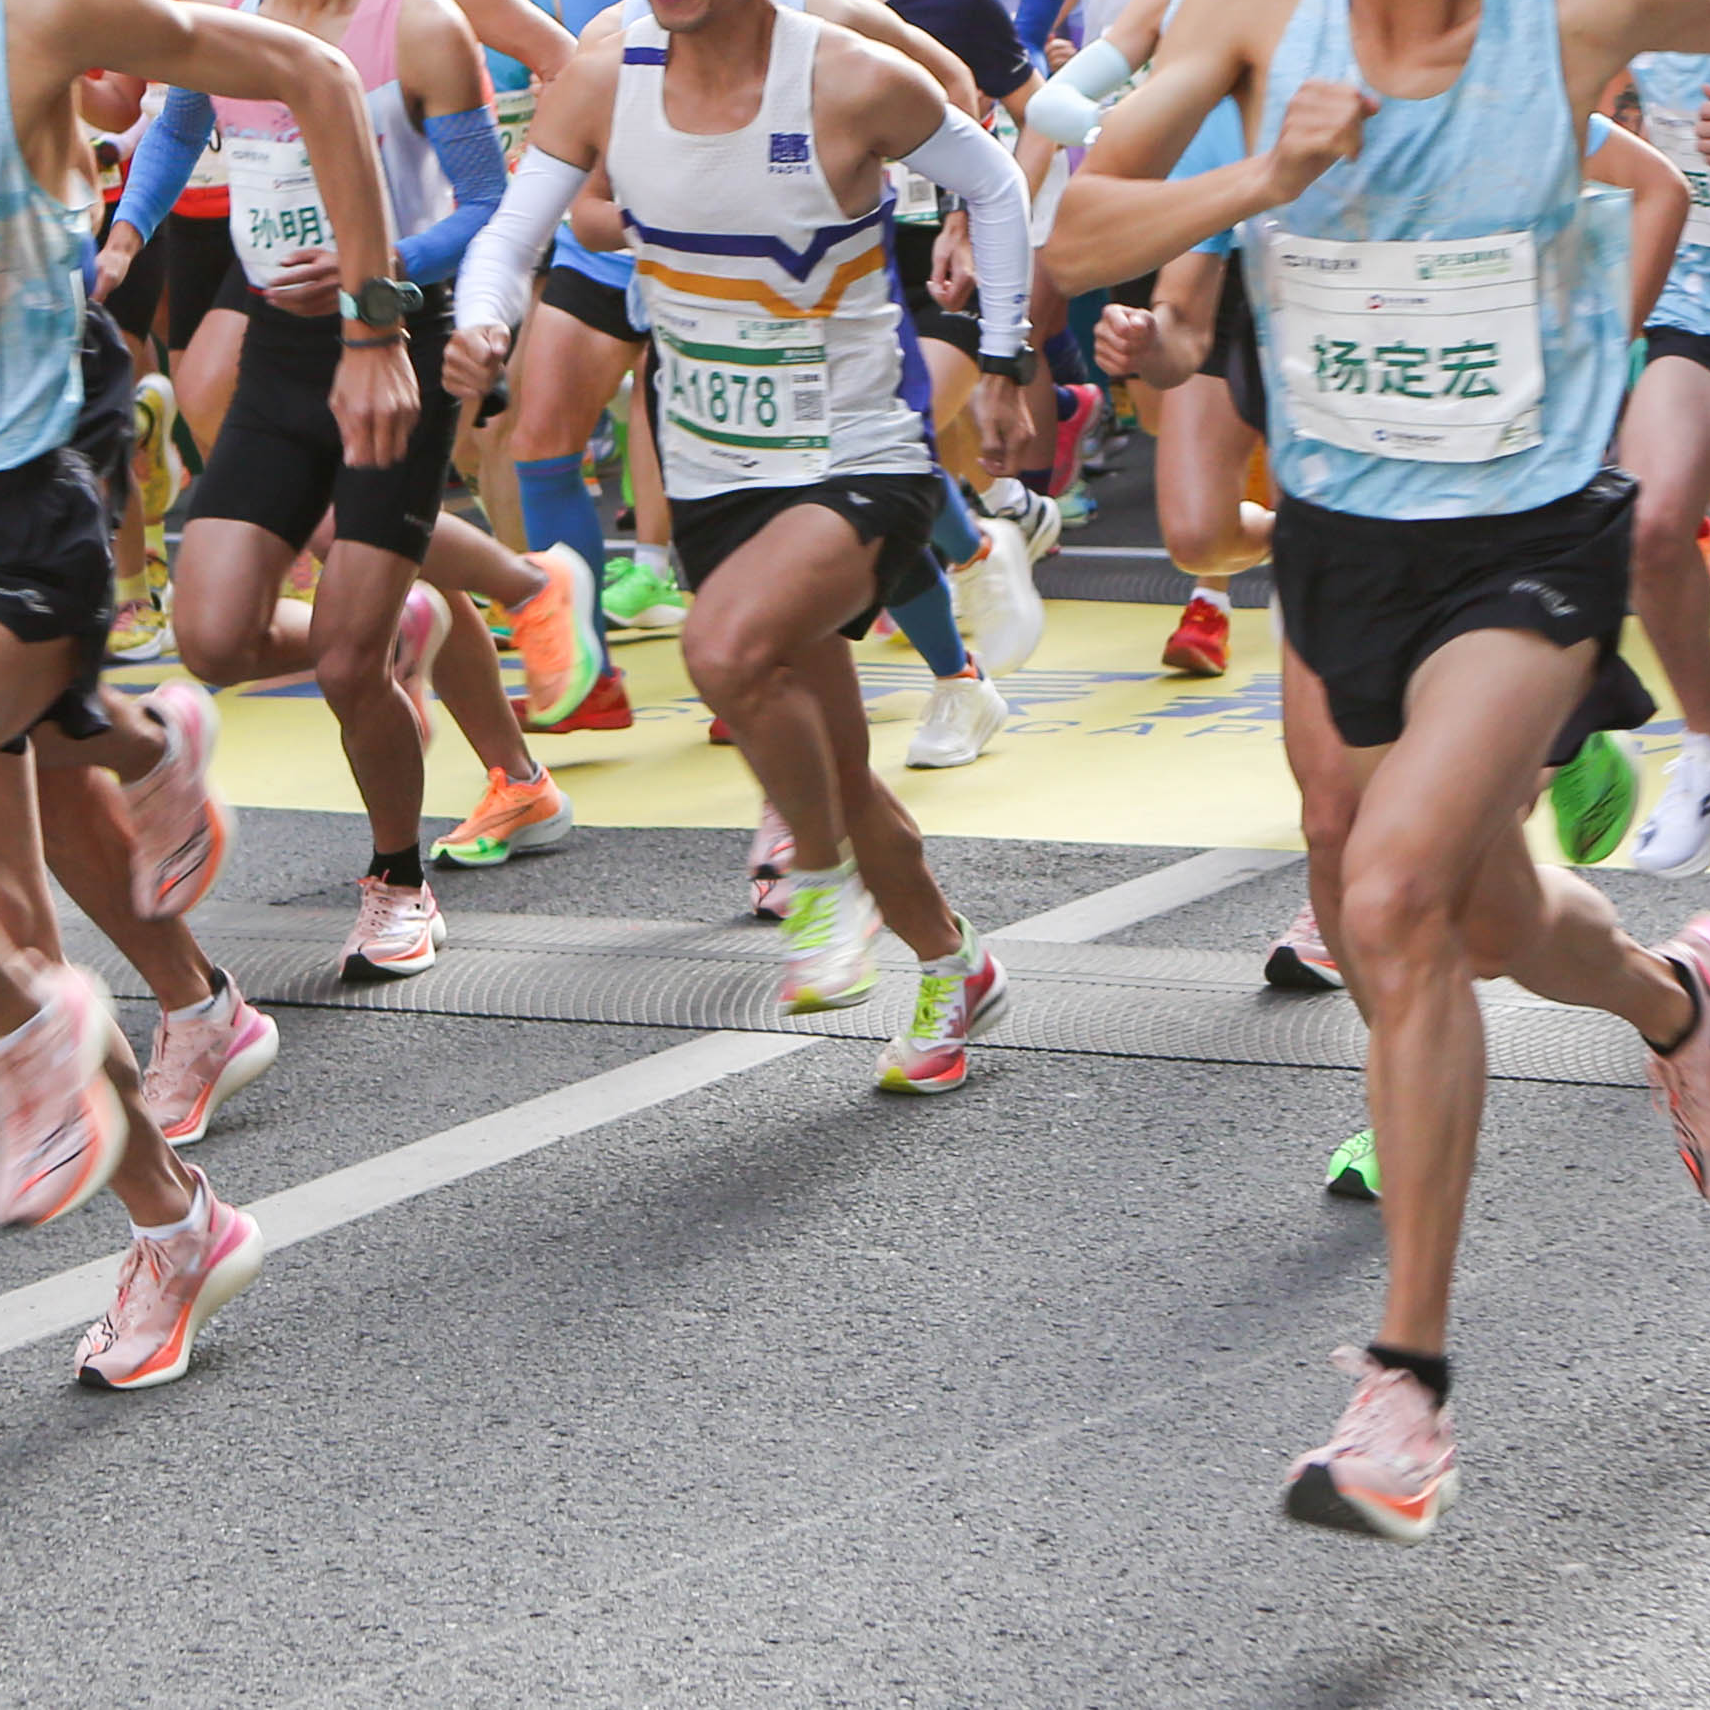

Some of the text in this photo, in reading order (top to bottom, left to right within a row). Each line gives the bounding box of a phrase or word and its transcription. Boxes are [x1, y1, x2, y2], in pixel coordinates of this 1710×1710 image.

[250, 204, 336, 249] 孙明
[1310, 335, 1500, 399] 杨定宏
